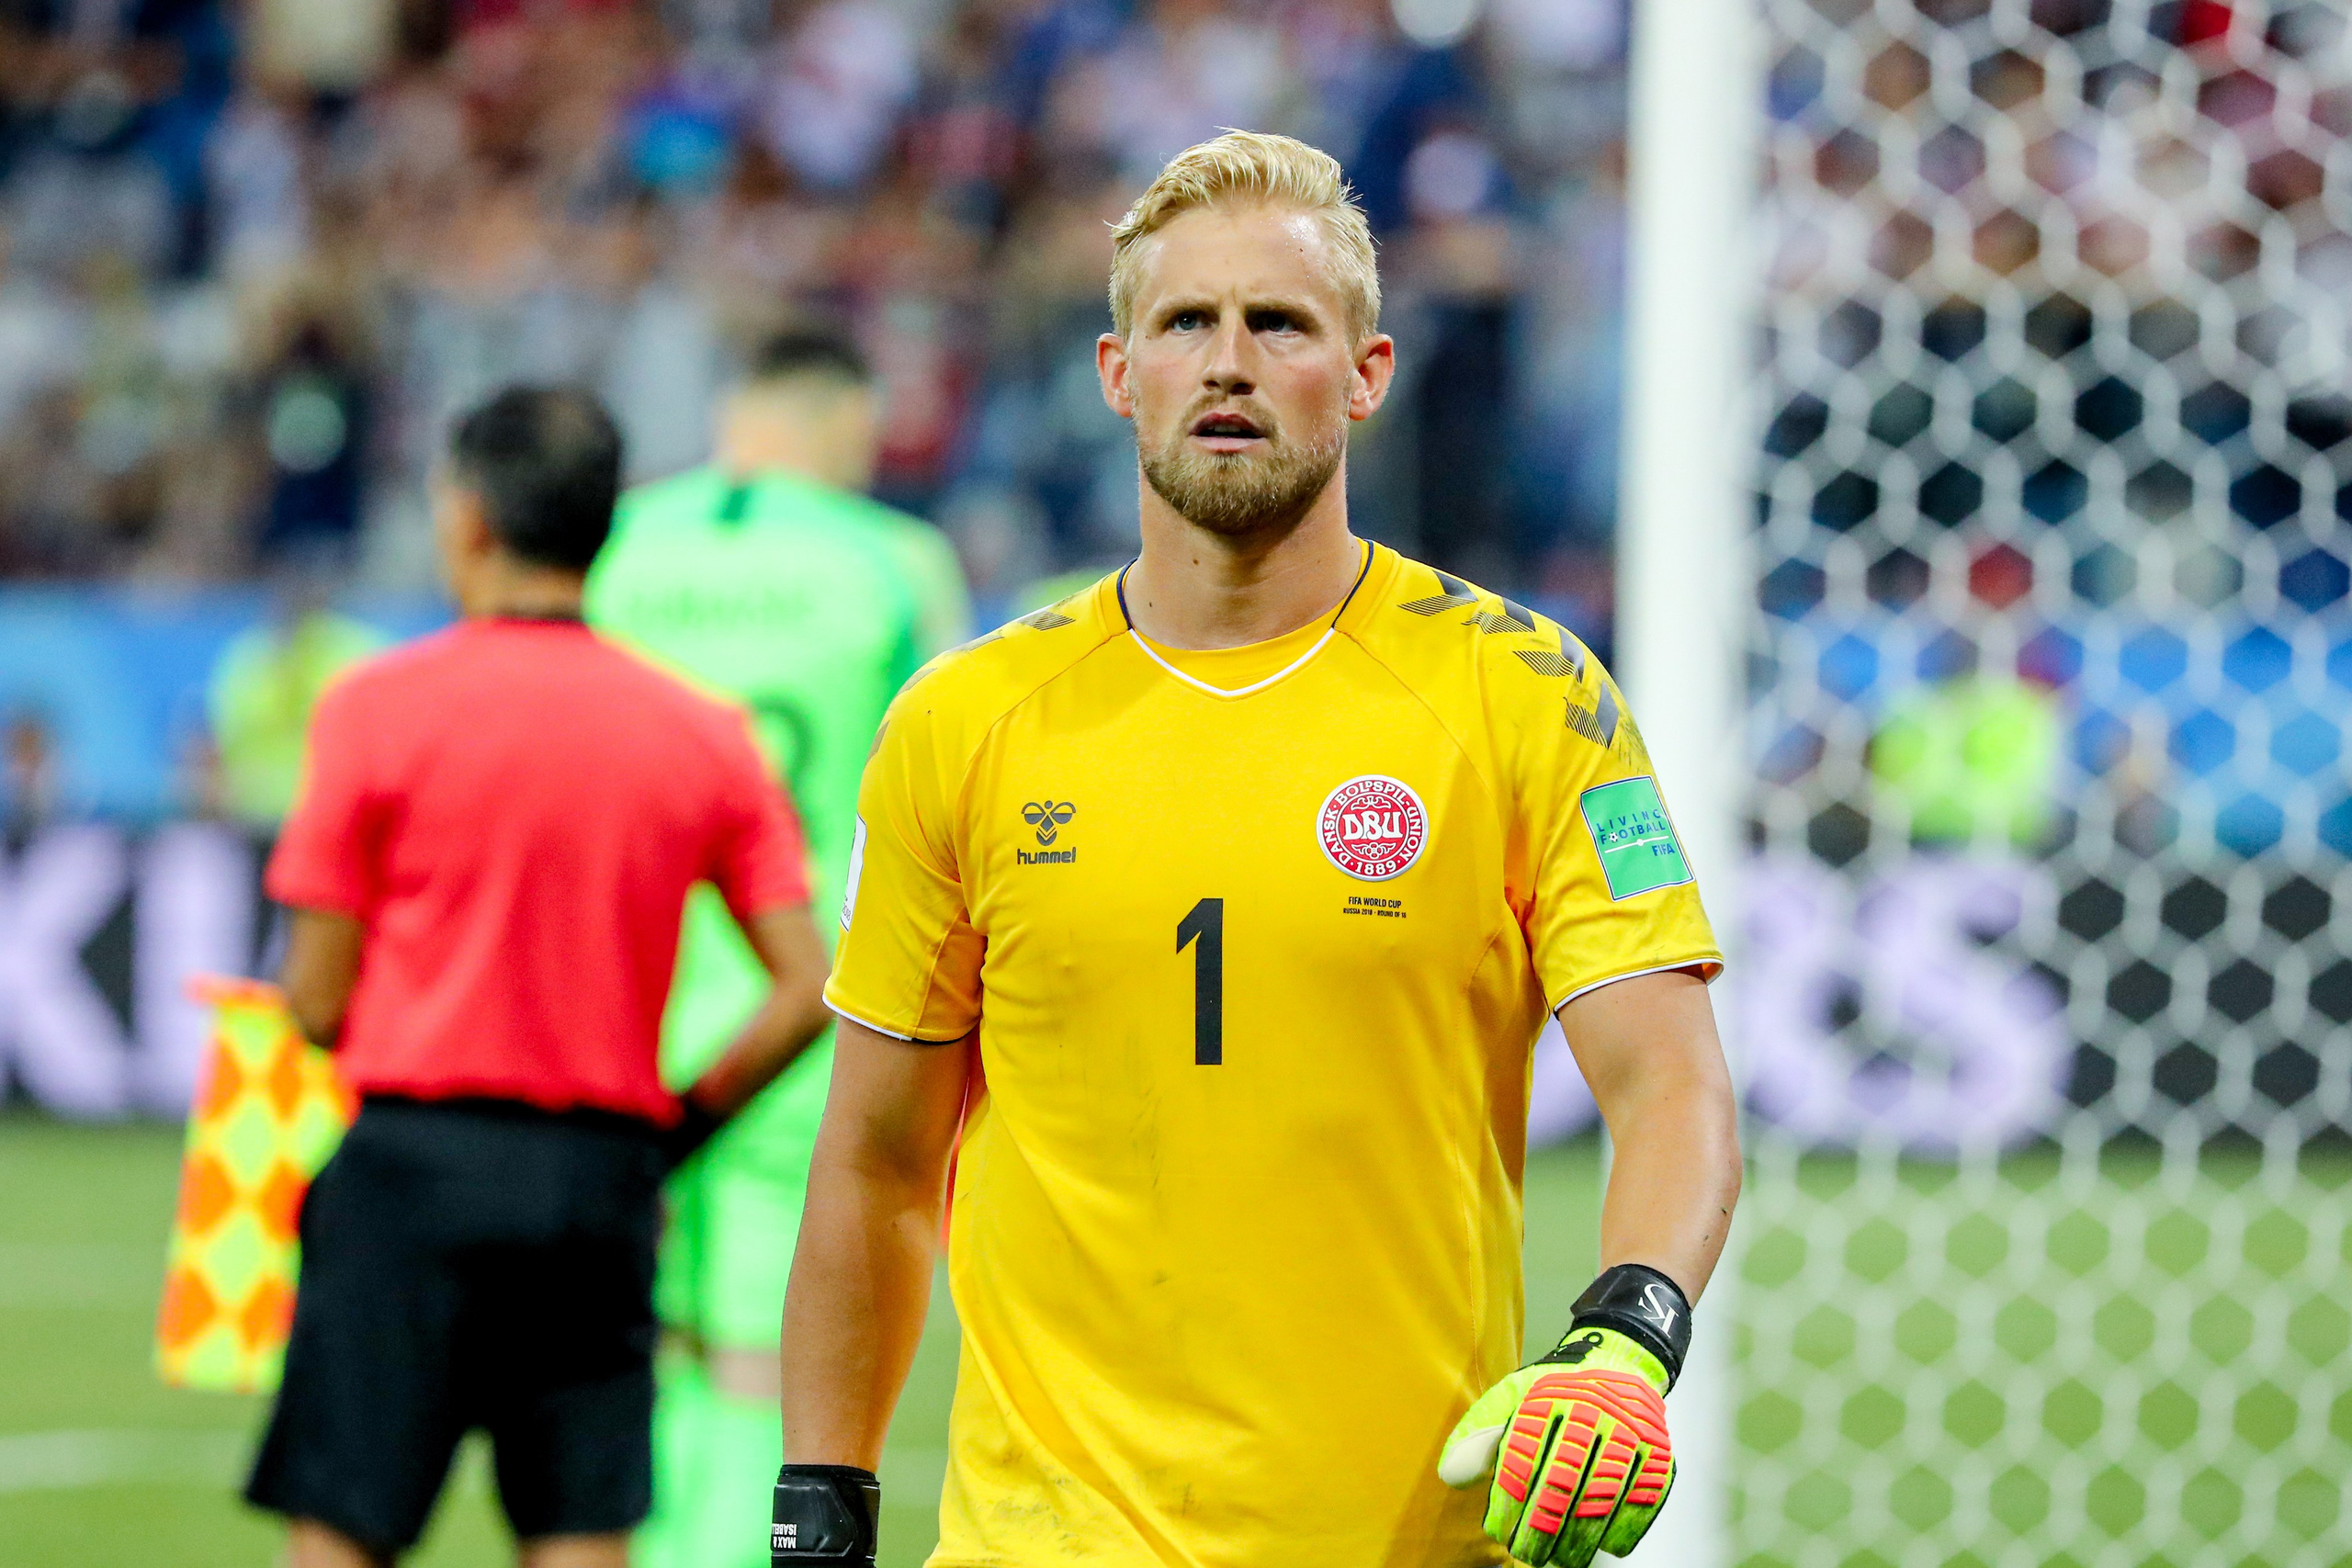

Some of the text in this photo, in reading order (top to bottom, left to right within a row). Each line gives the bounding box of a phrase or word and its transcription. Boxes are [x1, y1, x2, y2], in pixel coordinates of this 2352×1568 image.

[1341, 810, 1404, 840] DBU
[1596, 809, 1661, 832] LIVING
[1323, 808, 1351, 865] DANSK
[1017, 847, 1076, 864] hummel
[1652, 843, 1676, 856] FIFA
[1355, 861, 1396, 875] 1889
[1348, 897, 1402, 908] FIFA WORLD CUP
[1377, 909, 1393, 918] ROUND
[1176, 898, 1224, 1065] 1
[777, 1537, 797, 1549] MAX
